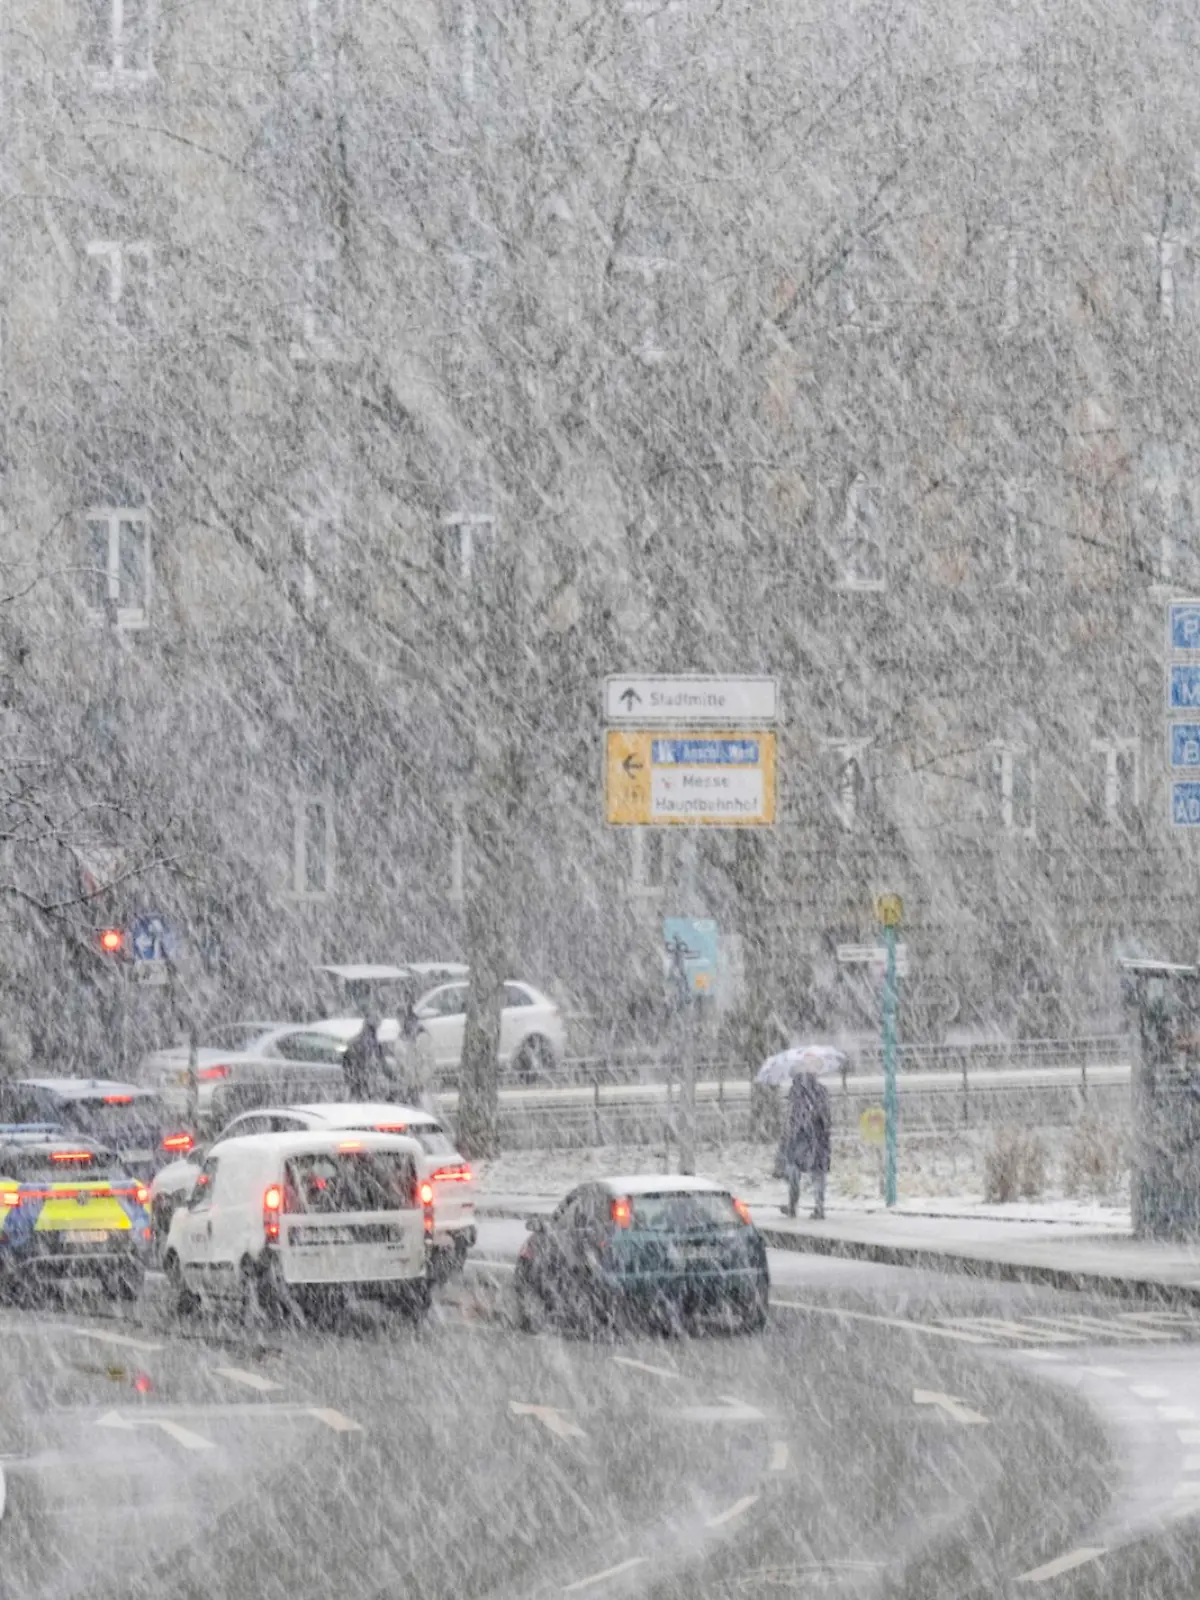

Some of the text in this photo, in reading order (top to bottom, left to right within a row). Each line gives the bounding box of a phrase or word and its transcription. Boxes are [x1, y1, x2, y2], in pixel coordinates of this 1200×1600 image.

[650, 691, 726, 707] Stadtmitte
[682, 775, 729, 788] Messe
[656, 797, 758, 813] Hauptbahnhof
